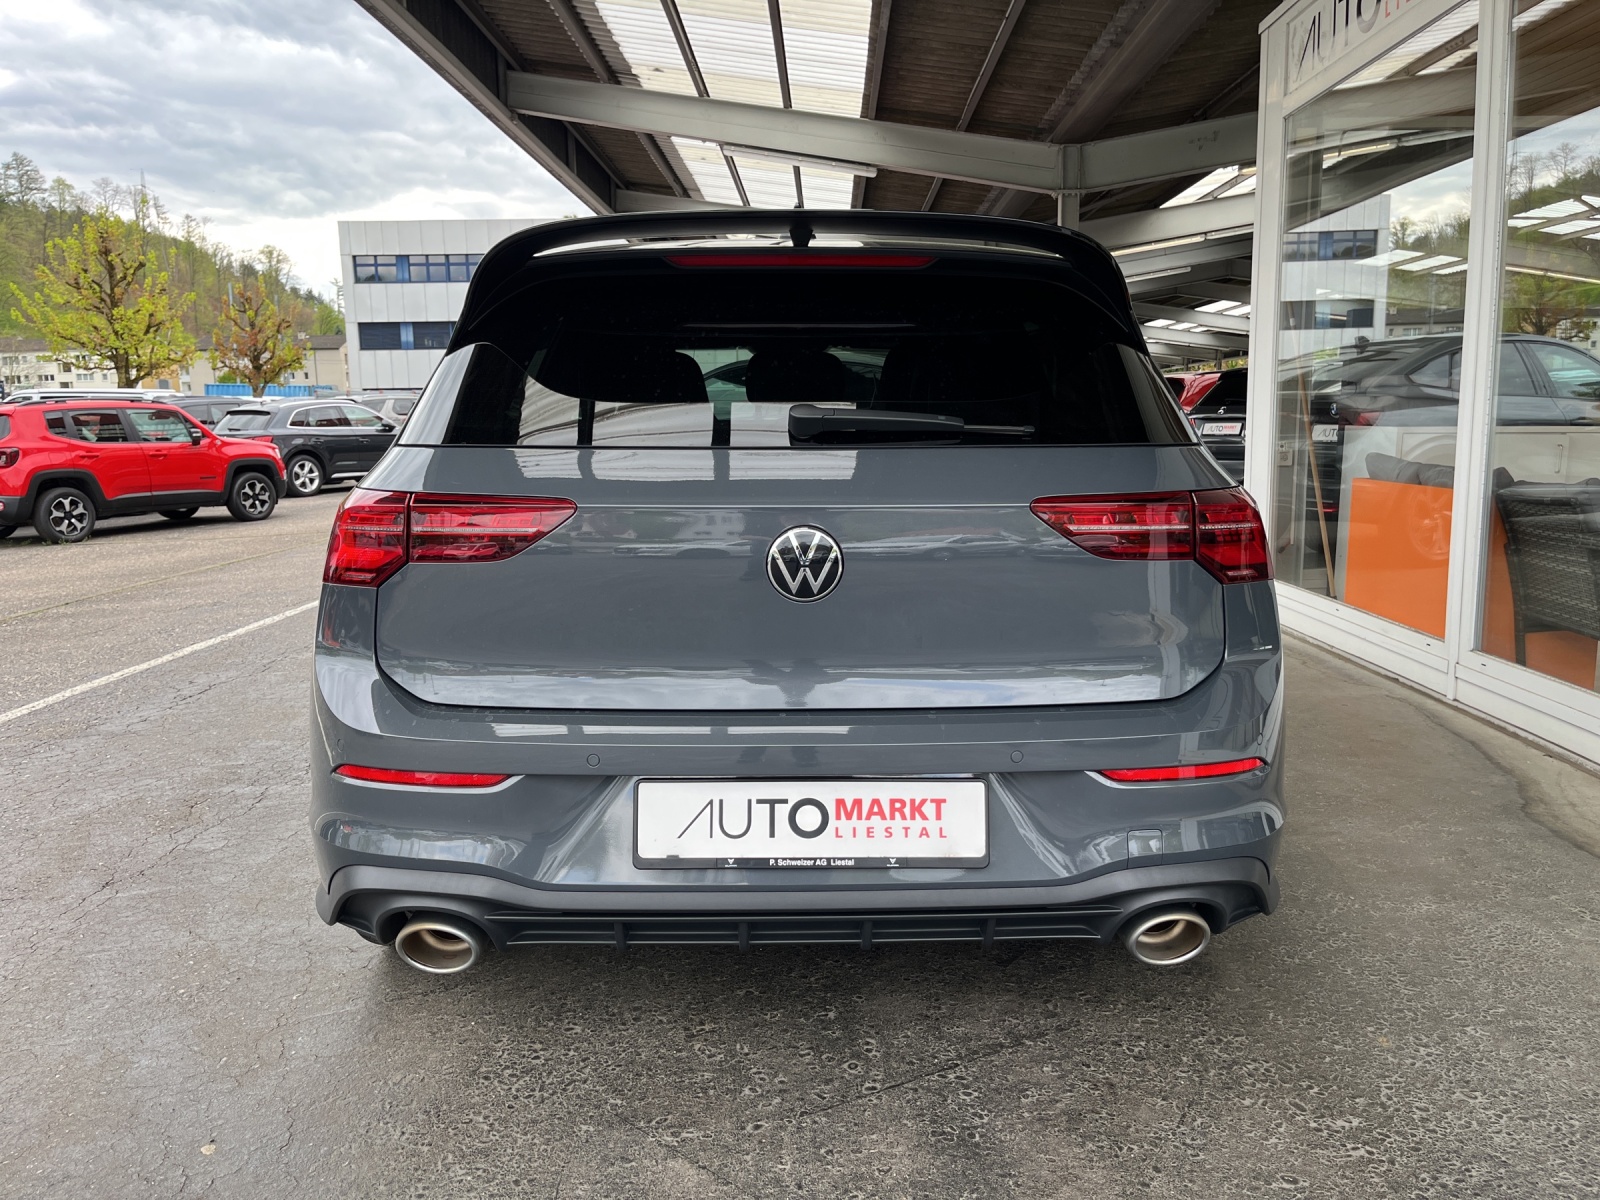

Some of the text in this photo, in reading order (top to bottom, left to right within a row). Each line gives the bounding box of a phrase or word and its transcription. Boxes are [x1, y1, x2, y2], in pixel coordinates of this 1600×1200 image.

[677, 797, 830, 840] AUTO
[834, 798, 948, 821] MARKT
[834, 826, 948, 839] LIESTAL
[769, 858, 855, 866] P. Schweizer AG Liestal
